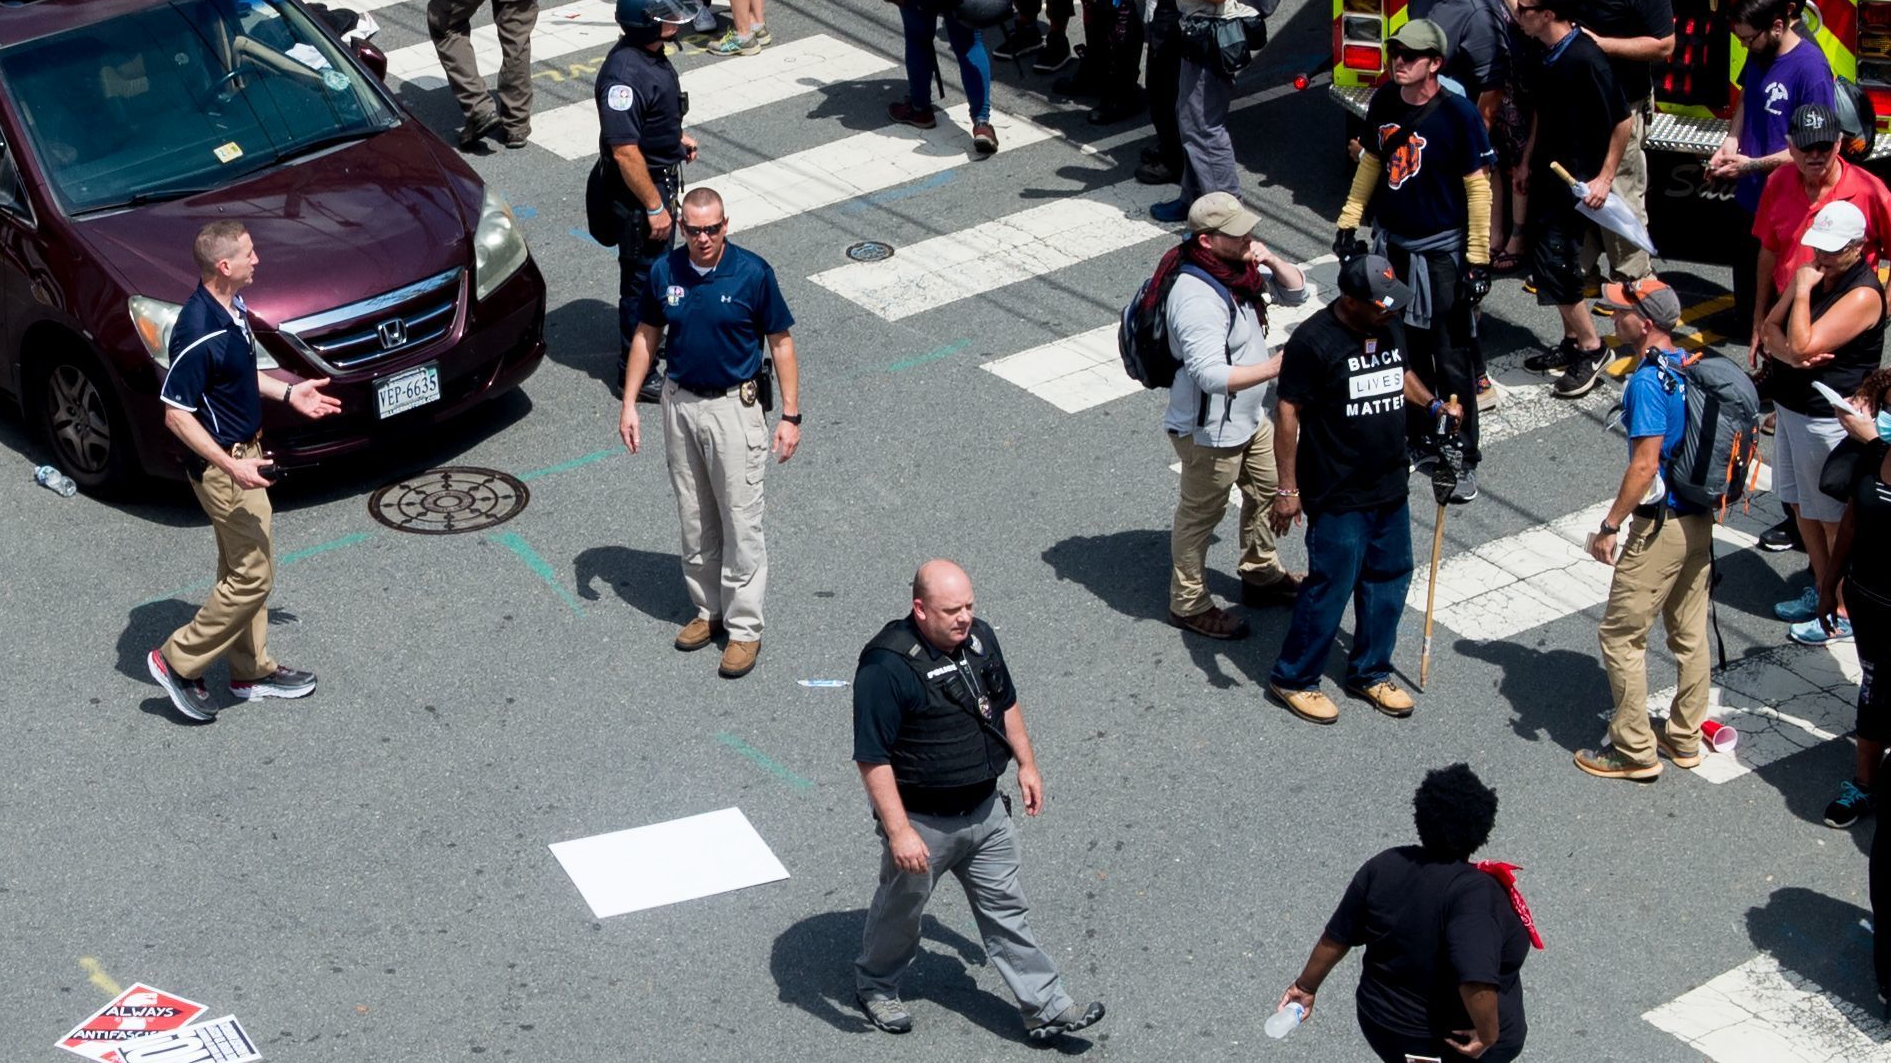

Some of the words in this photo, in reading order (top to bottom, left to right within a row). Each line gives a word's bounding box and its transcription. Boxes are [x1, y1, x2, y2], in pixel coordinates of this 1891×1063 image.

[1347, 348, 1402, 373] BLACK
[380, 374, 438, 409] VEP-6635
[1356, 373, 1402, 393] LIVES
[105, 1006, 174, 1018] ALWAYS
